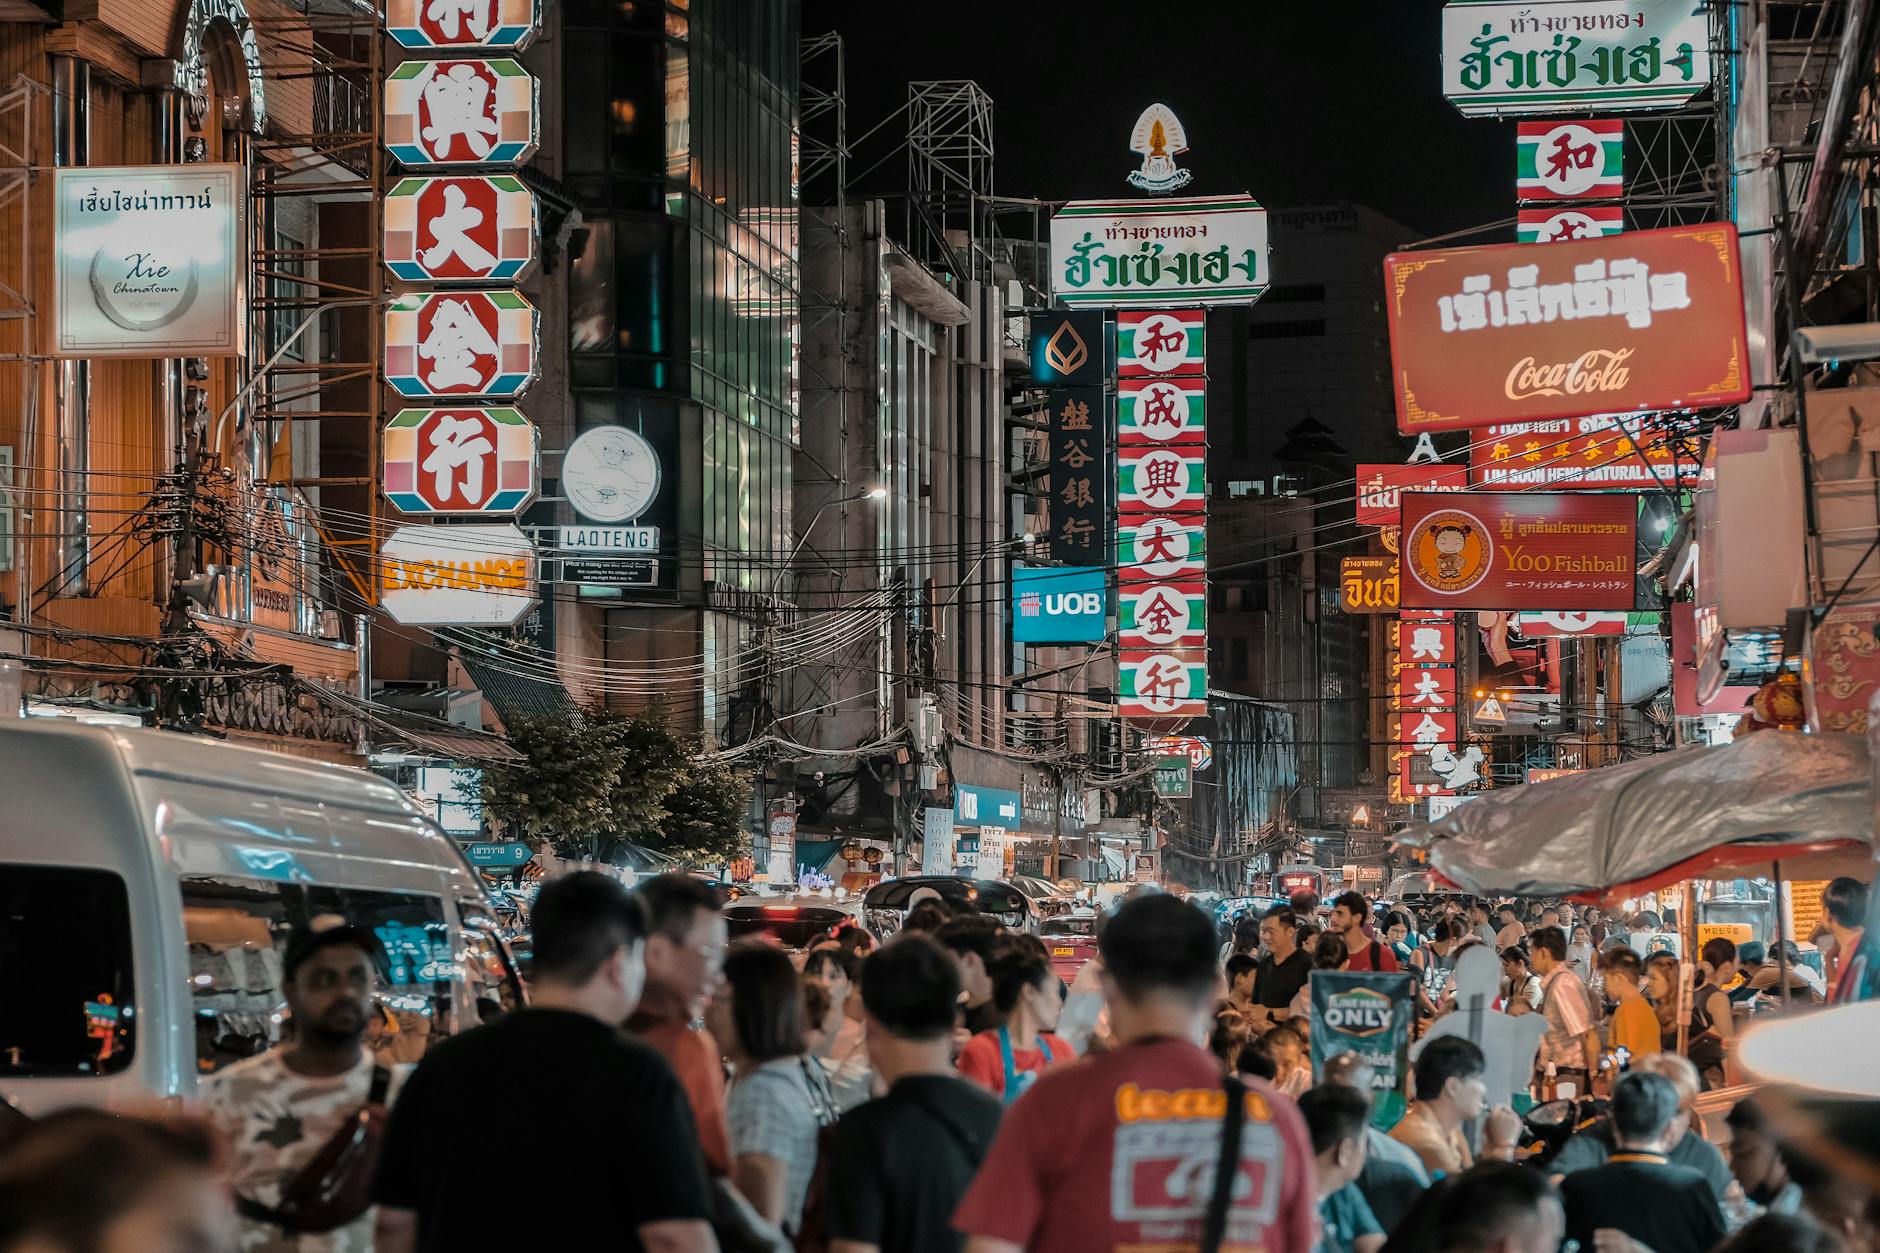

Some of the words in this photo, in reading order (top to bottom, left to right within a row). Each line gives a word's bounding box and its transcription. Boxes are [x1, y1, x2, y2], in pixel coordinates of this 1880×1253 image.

[1510, 9, 1644, 34] ห้างขายทอง
[1460, 23, 1694, 90] ฮั่วเซ่งเฮง
[1105, 221, 1207, 241] ห้างขายทอง
[125, 253, 170, 280] Xie
[1064, 231, 1257, 287] ฮั่วเซ่งเฮง
[113, 281, 180, 295] Chinatown
[1504, 347, 1636, 401] Coca-Cola
[1059, 398, 1096, 548] 盤谷銀行
[1483, 469, 1507, 484] LIM
[1509, 468, 1545, 483] SOON
[1586, 466, 1645, 482] NATURAL
[1138, 321, 1185, 707] 和成興大金行
[567, 530, 648, 547] LAOTENG
[383, 559, 527, 590] EXCHANGE
[1553, 554, 1629, 573] Fishball
[1045, 592, 1102, 615] UOB
[963, 791, 978, 820] UOB
[515, 847, 523, 859] 9
[1324, 1007, 1394, 1027] ONLY
